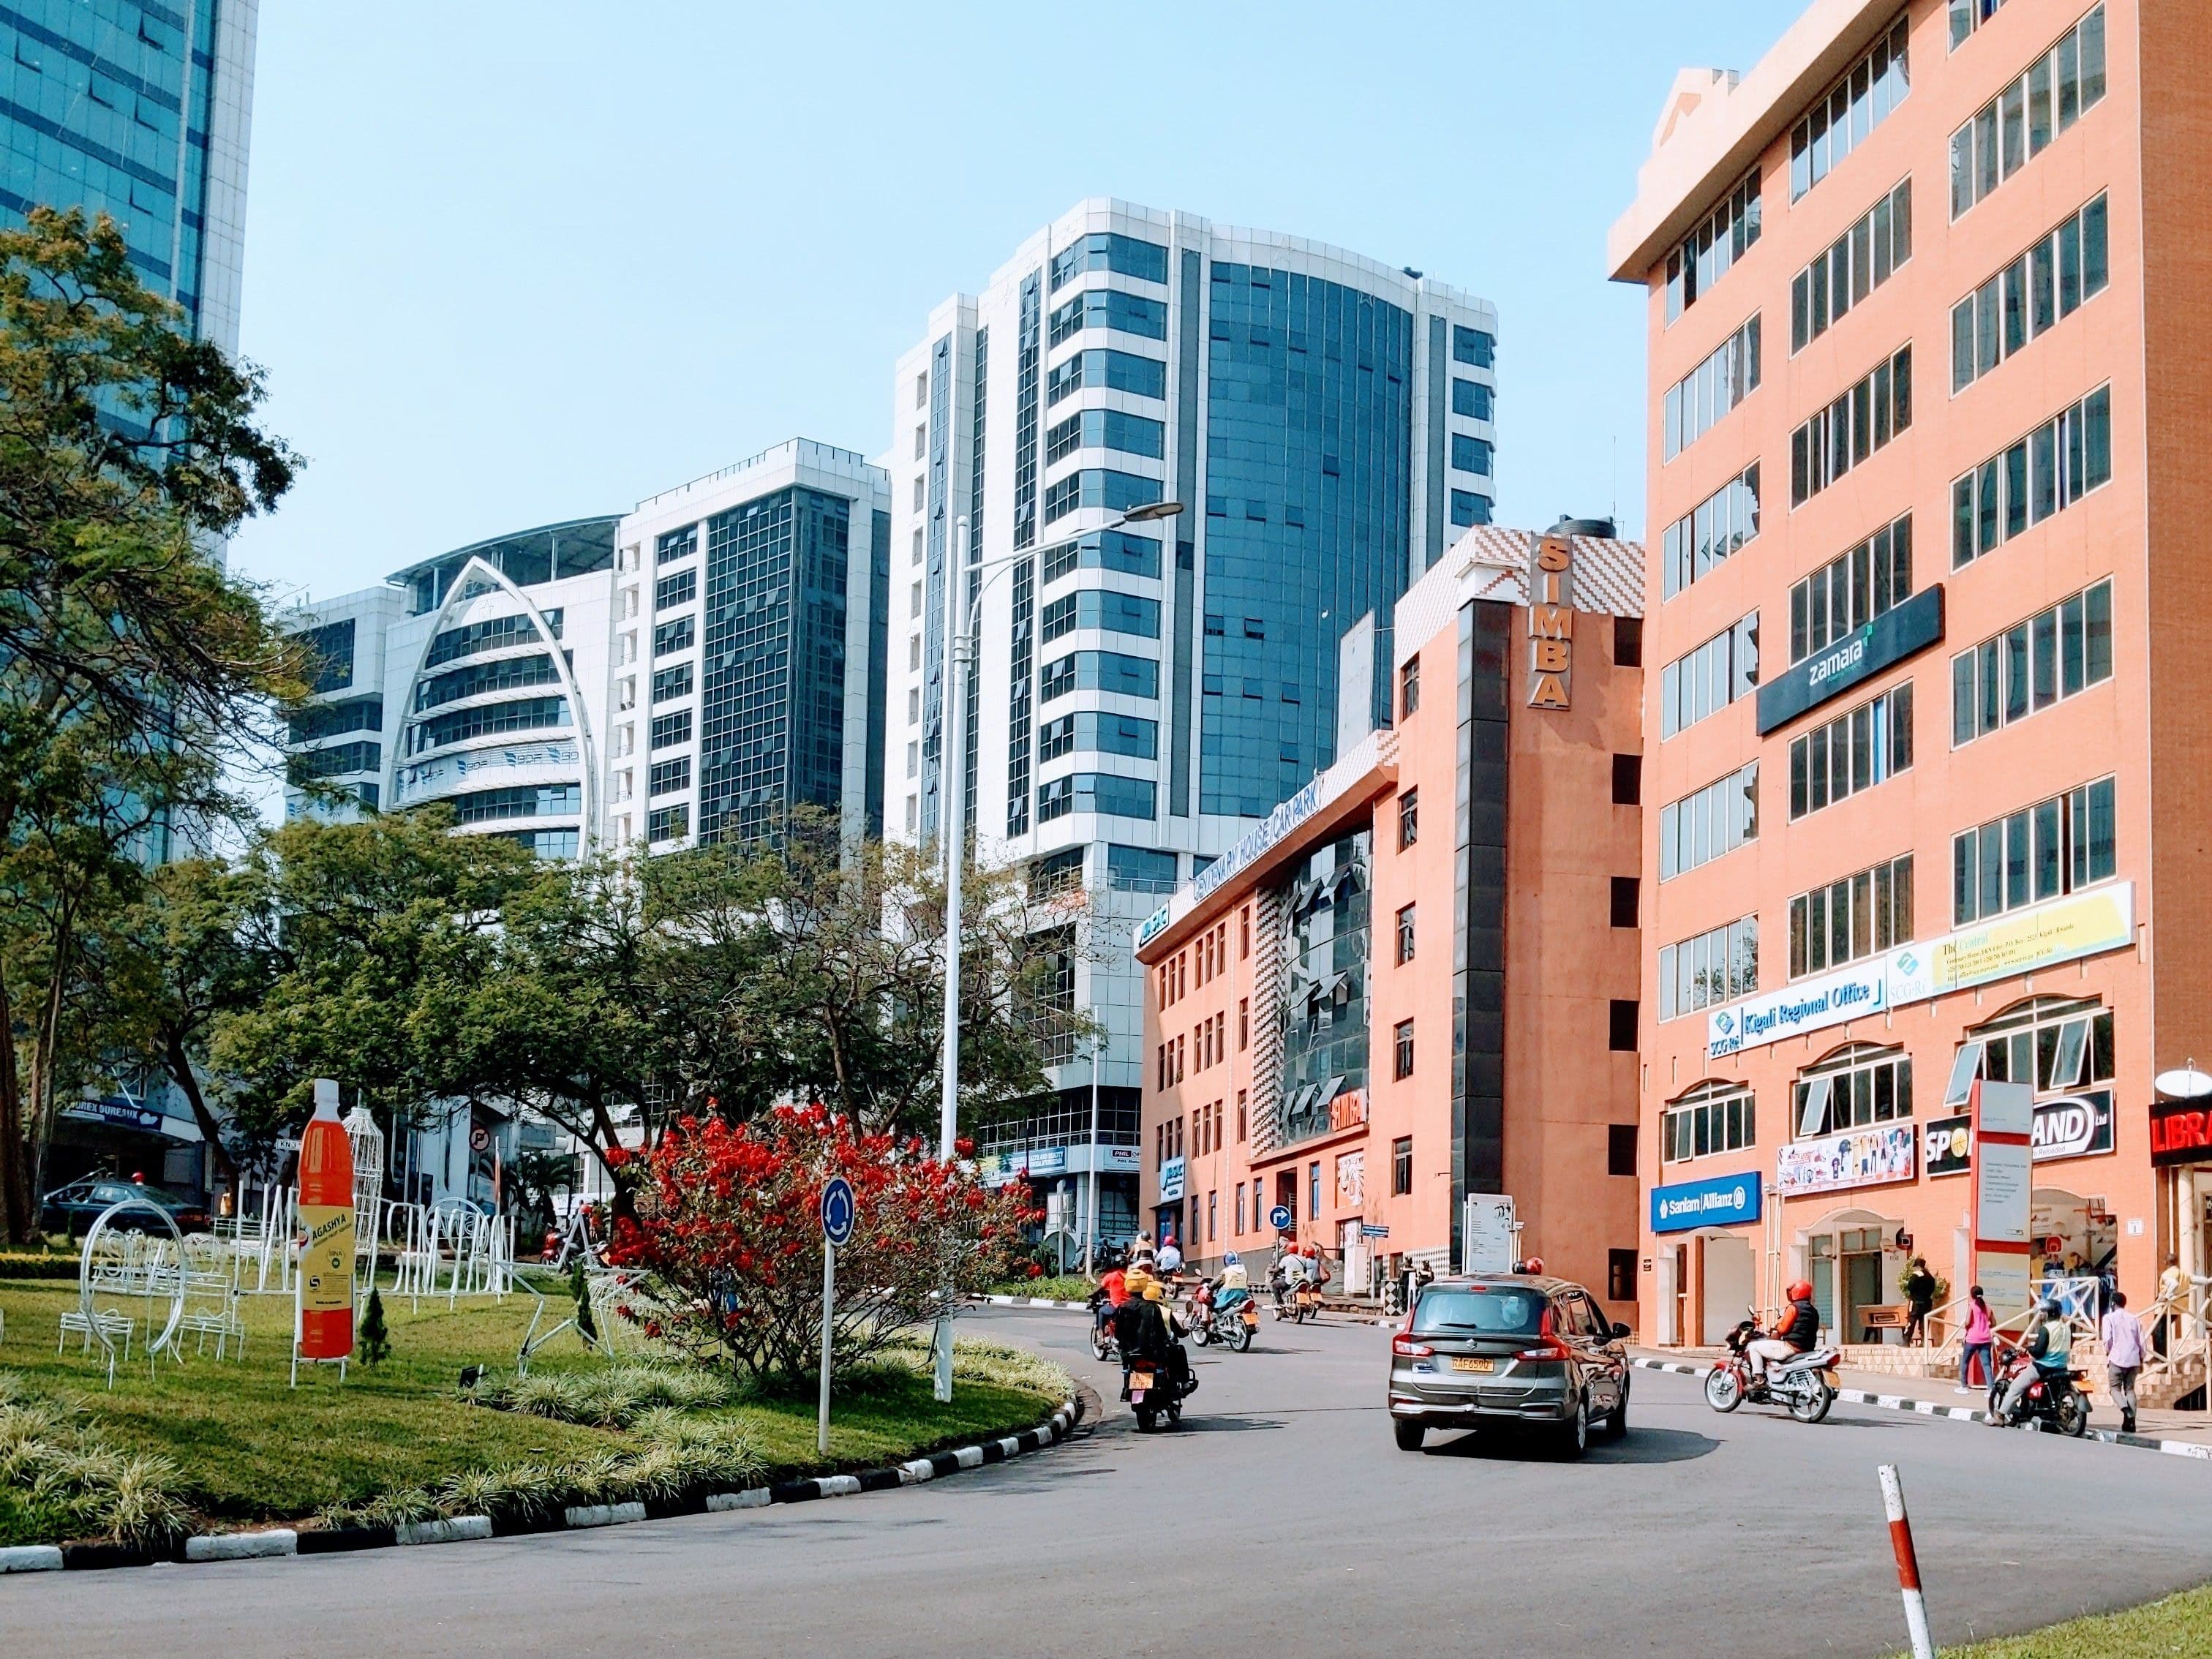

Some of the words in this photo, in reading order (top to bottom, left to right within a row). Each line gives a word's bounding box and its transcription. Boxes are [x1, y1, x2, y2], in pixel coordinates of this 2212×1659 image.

[1528, 538, 1573, 708] SIMBA
[1810, 640, 1863, 686] zamara
[1293, 781, 1317, 821] PARK
[1745, 1011, 1777, 1035] Kigali
[1778, 990, 1829, 1025] Regional
[1832, 982, 1870, 1009] Office
[1331, 1092, 1361, 1132] SIMBA
[2031, 1109, 2084, 1146] AND
[2095, 1113, 2107, 1126] Ltd
[2152, 1110, 2212, 1152] LIBR
[1669, 1197, 1700, 1215] Sanlam
[1703, 1192, 1733, 1211] Allianz
[312, 1213, 347, 1241] AGASHYA
